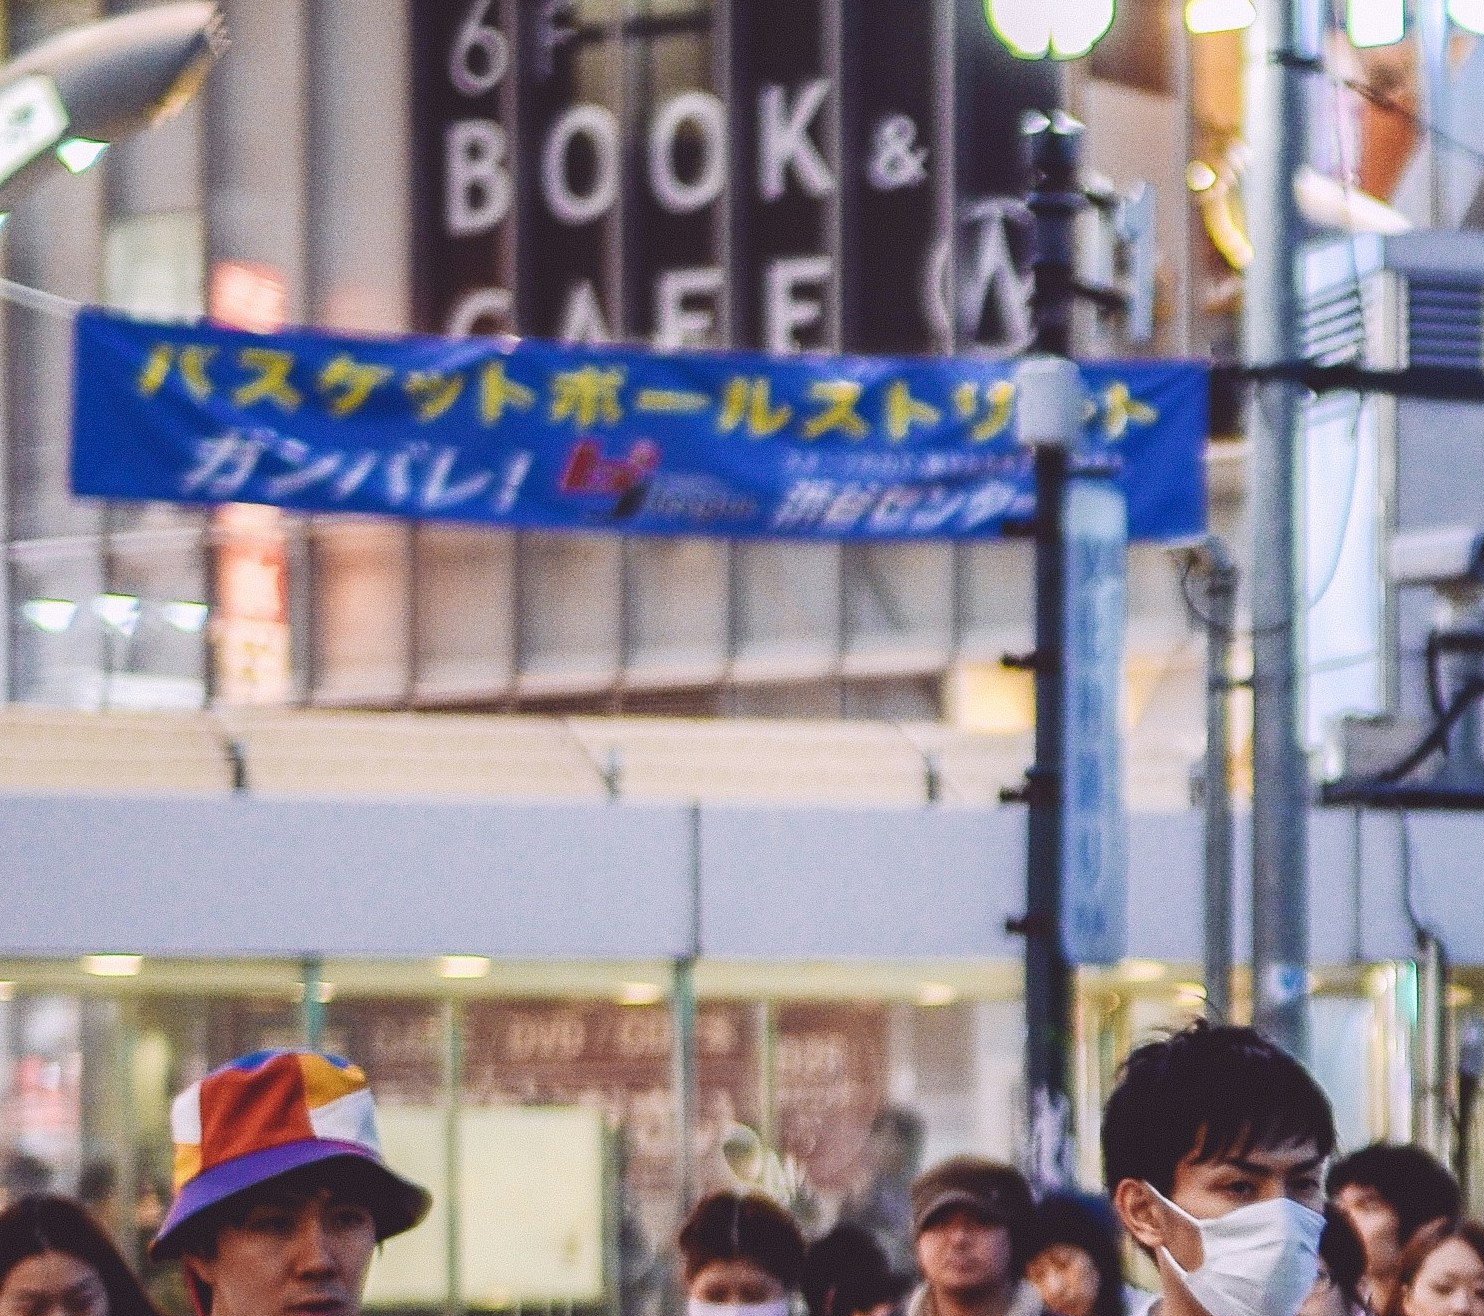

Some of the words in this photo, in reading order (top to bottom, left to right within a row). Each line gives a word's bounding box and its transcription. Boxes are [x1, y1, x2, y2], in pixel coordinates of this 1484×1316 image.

[446, 78, 838, 238] BOOK
[868, 114, 929, 190] &
[138, 345, 1160, 443] バスケットボールストリト
